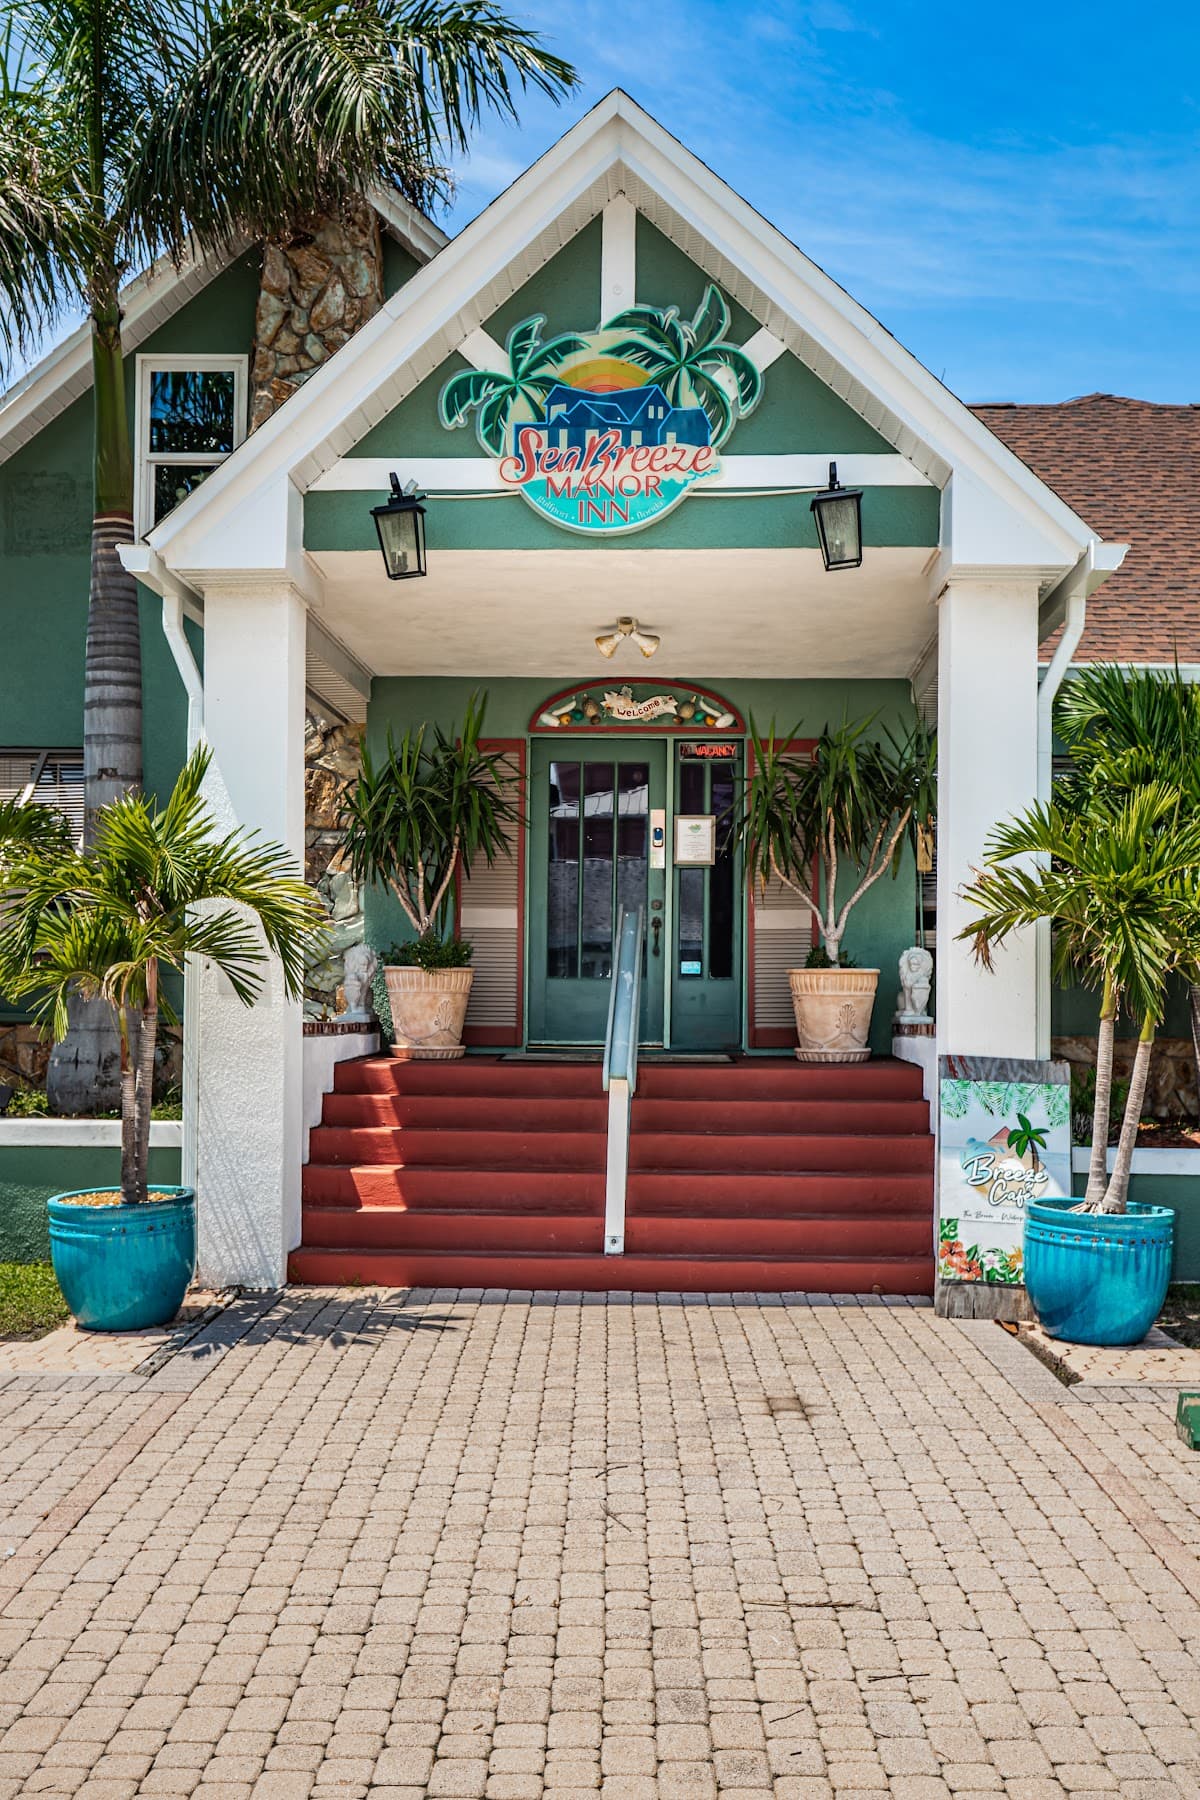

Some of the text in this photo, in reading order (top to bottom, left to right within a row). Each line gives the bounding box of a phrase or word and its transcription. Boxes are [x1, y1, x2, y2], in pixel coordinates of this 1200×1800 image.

[545, 475, 664, 499] MANOR
[577, 499, 630, 523] INN
[695, 744, 737, 757] VACANCY
[962, 1153, 1049, 1187] Breeze
